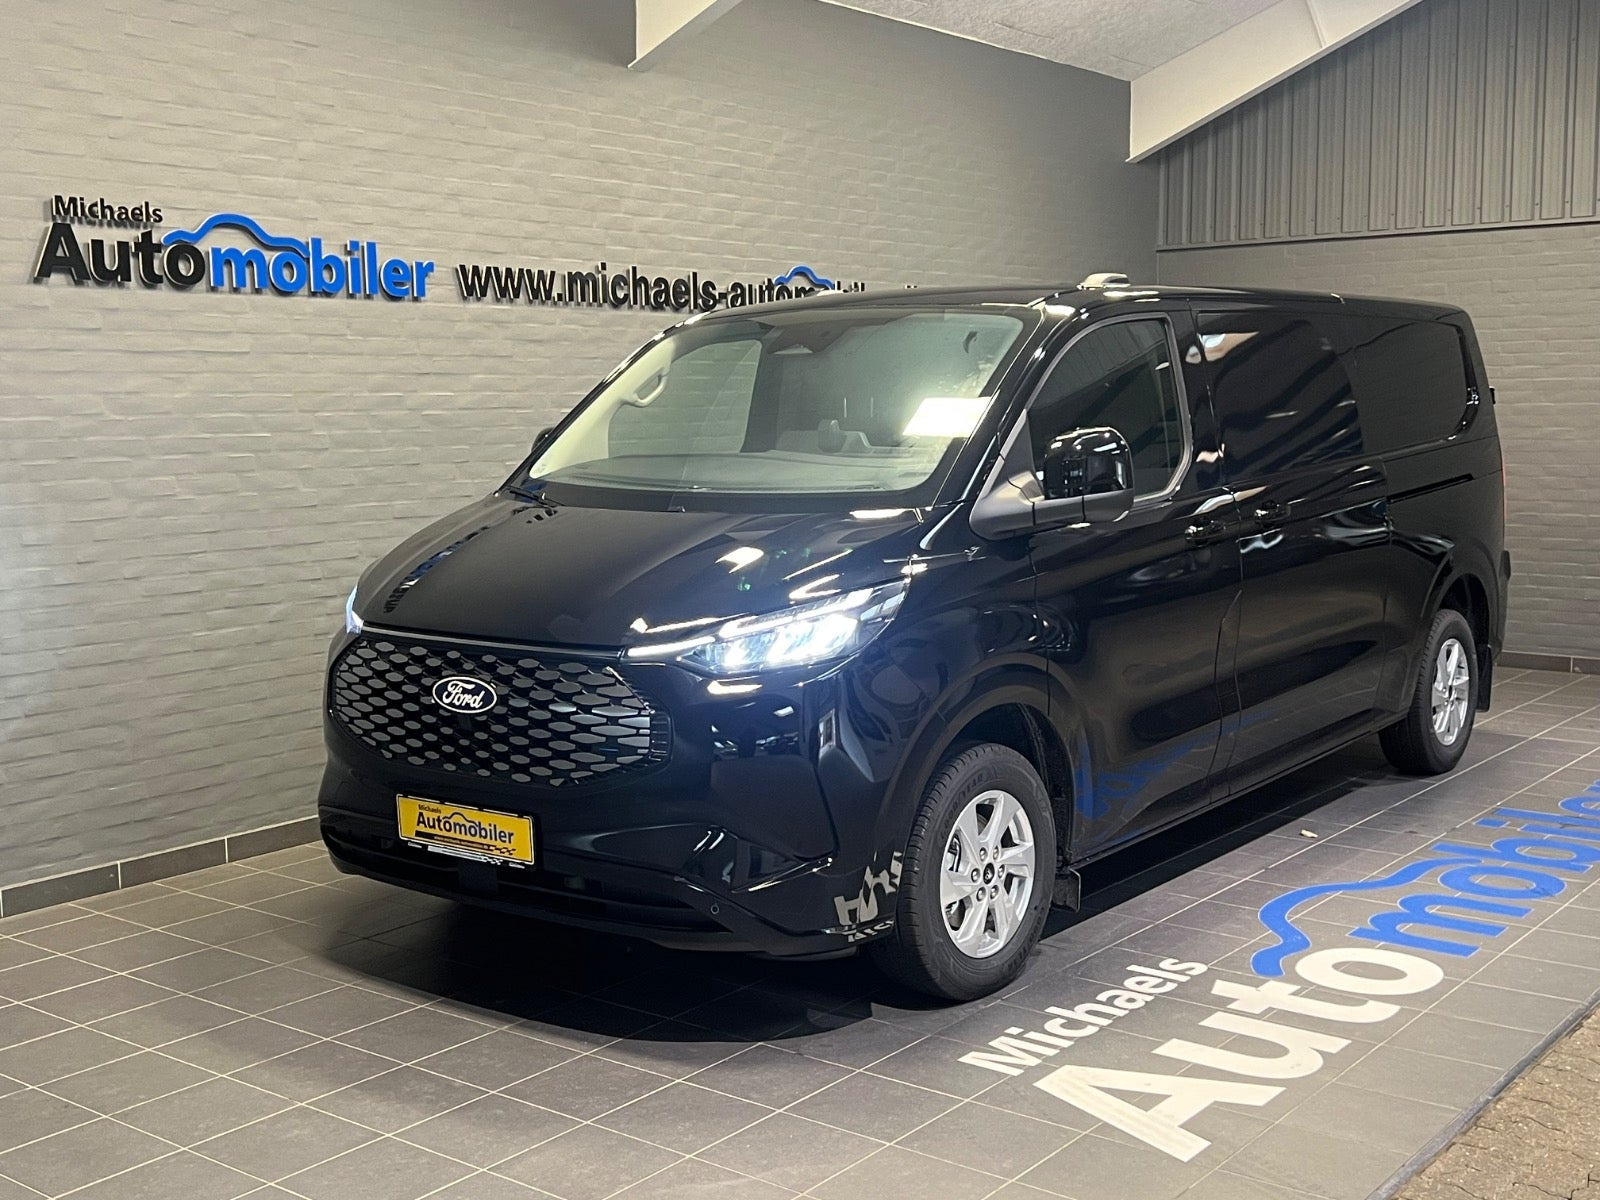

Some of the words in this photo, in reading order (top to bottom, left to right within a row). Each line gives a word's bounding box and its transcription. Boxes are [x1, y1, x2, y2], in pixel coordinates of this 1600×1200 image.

[52, 194, 164, 224] Michaels
[34, 220, 435, 299] Automobiler
[442, 680, 486, 709] Ford
[418, 803, 442, 815] Michaels
[416, 811, 515, 844] Automobiler
[1033, 778, 1600, 1163] Automobil
[956, 957, 1209, 1077] Michaels
